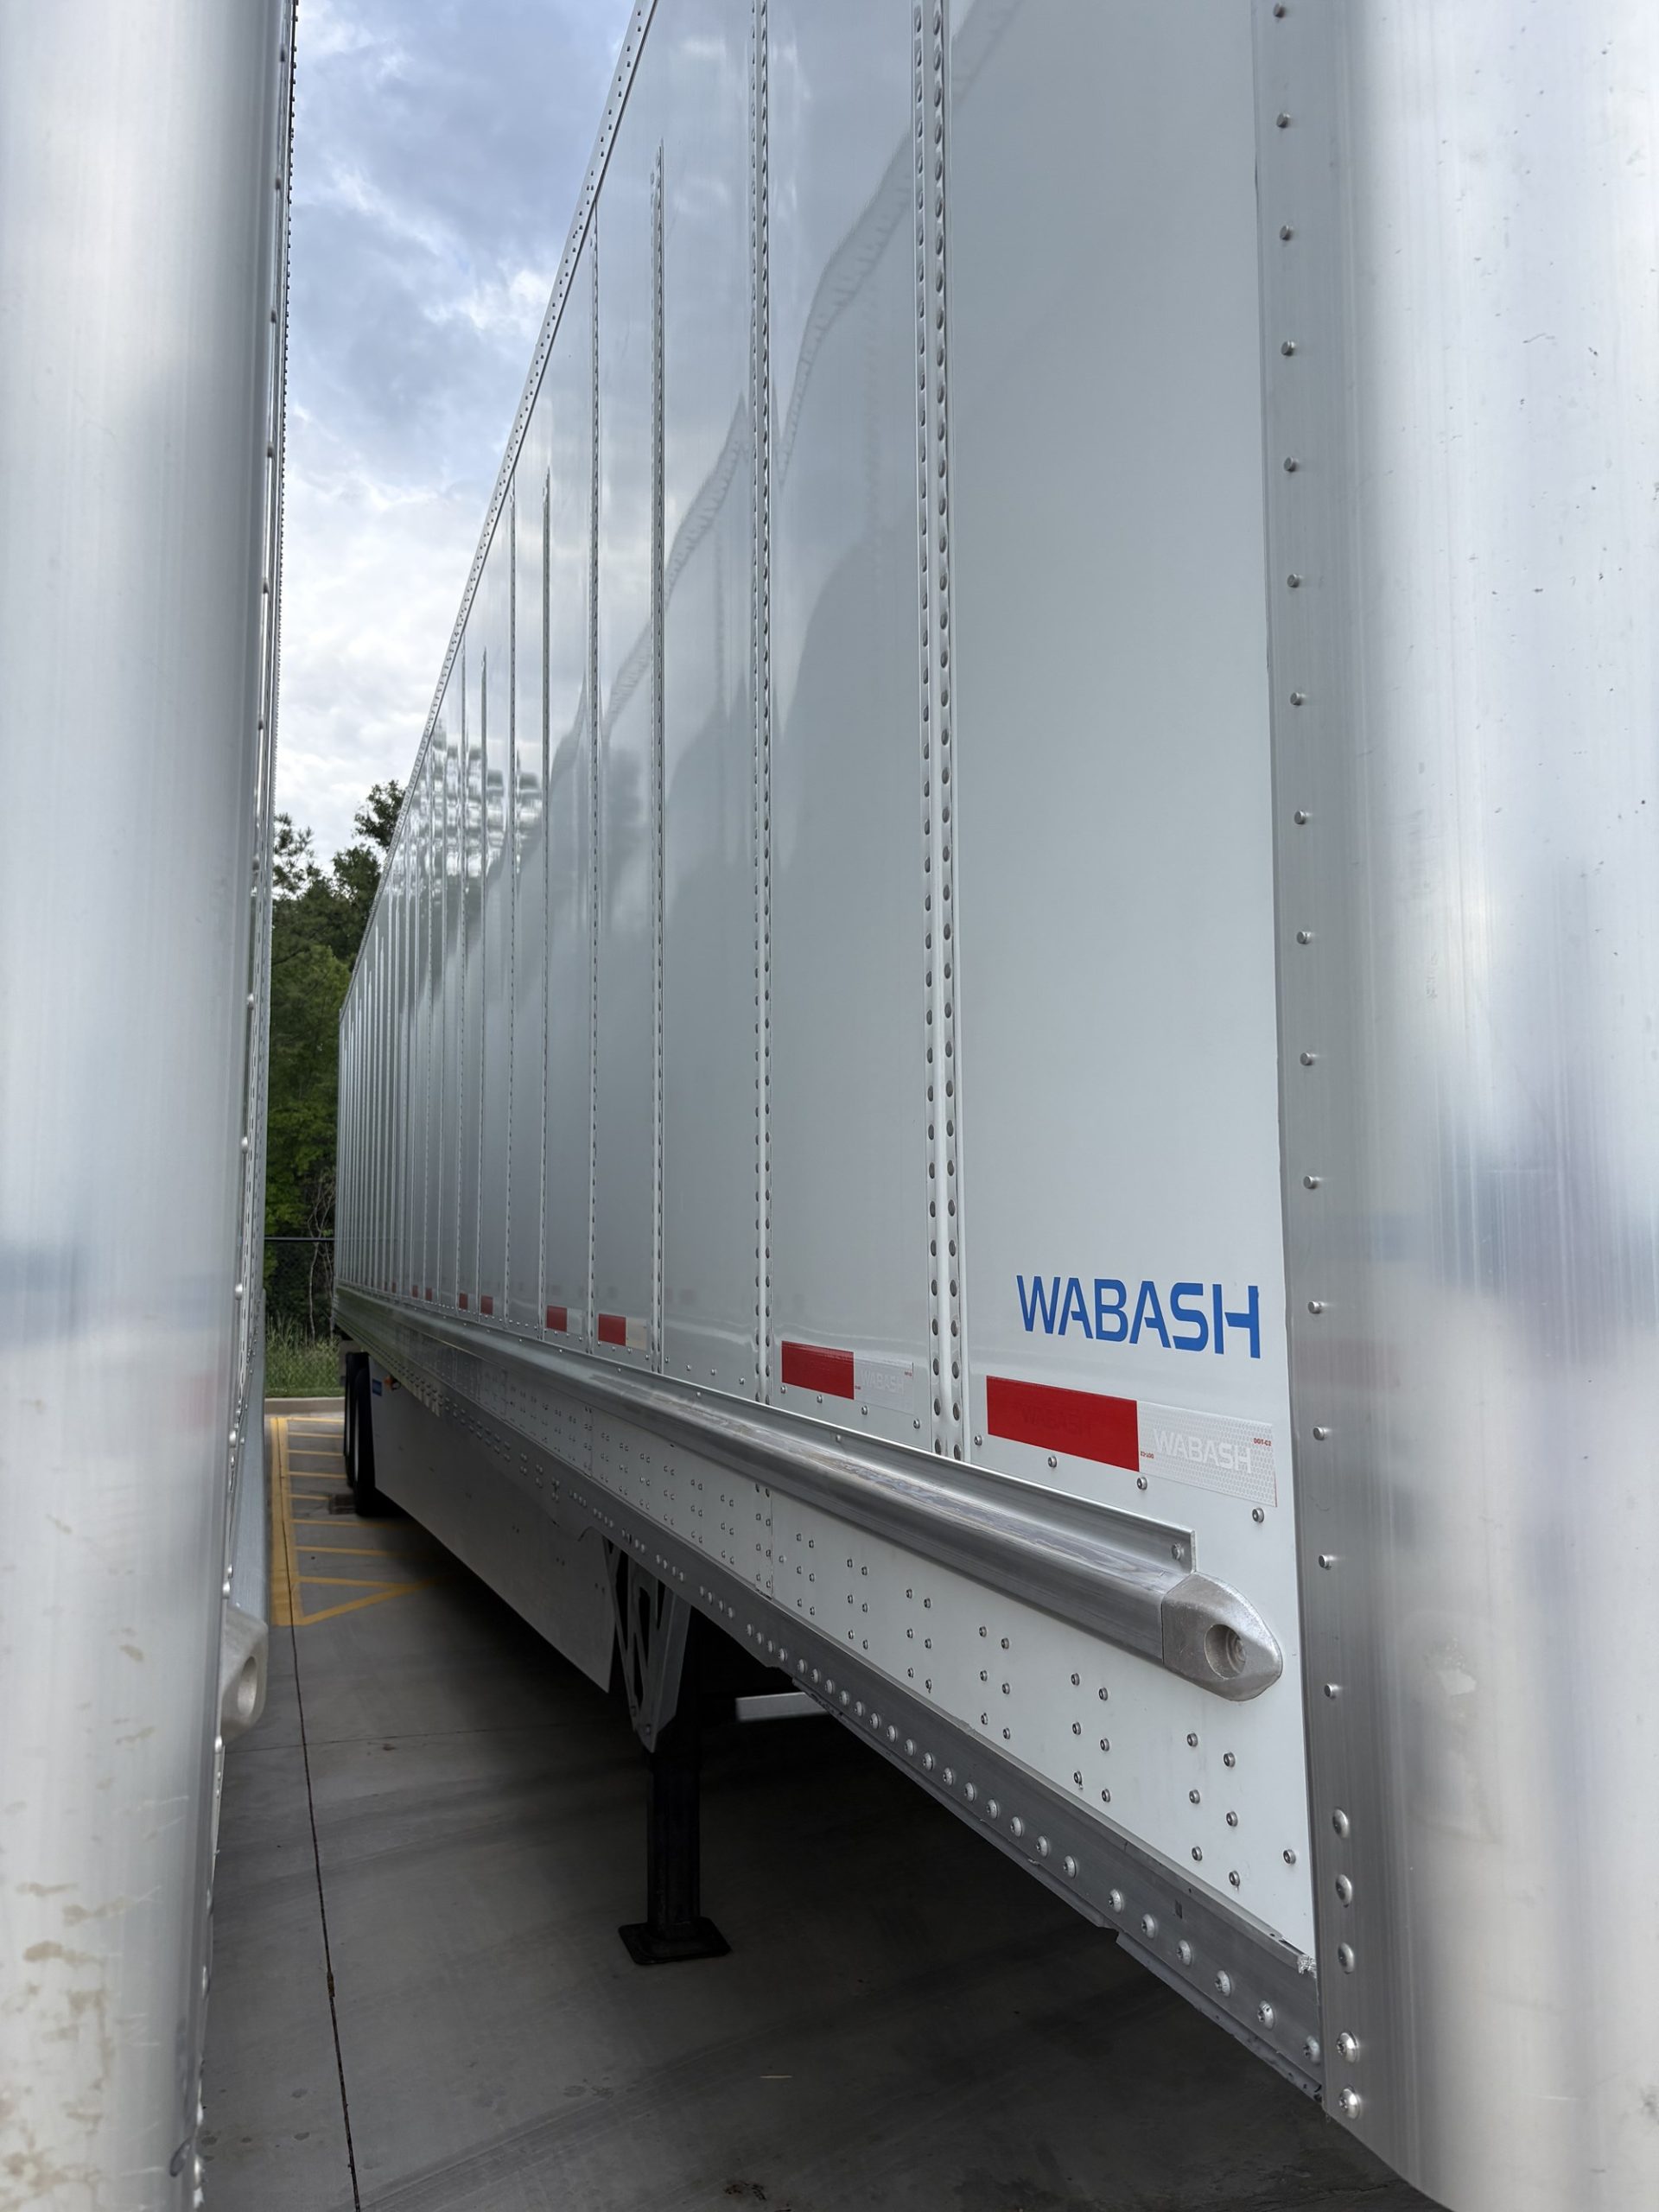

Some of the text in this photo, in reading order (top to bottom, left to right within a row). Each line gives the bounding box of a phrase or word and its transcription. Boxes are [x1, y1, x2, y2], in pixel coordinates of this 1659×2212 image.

[1016, 1274, 1261, 1359] WABASH
[861, 1370, 905, 1397] WABASH
[1154, 1429, 1251, 1474] WABASH
[1253, 1437, 1272, 1447] DOT-C2
